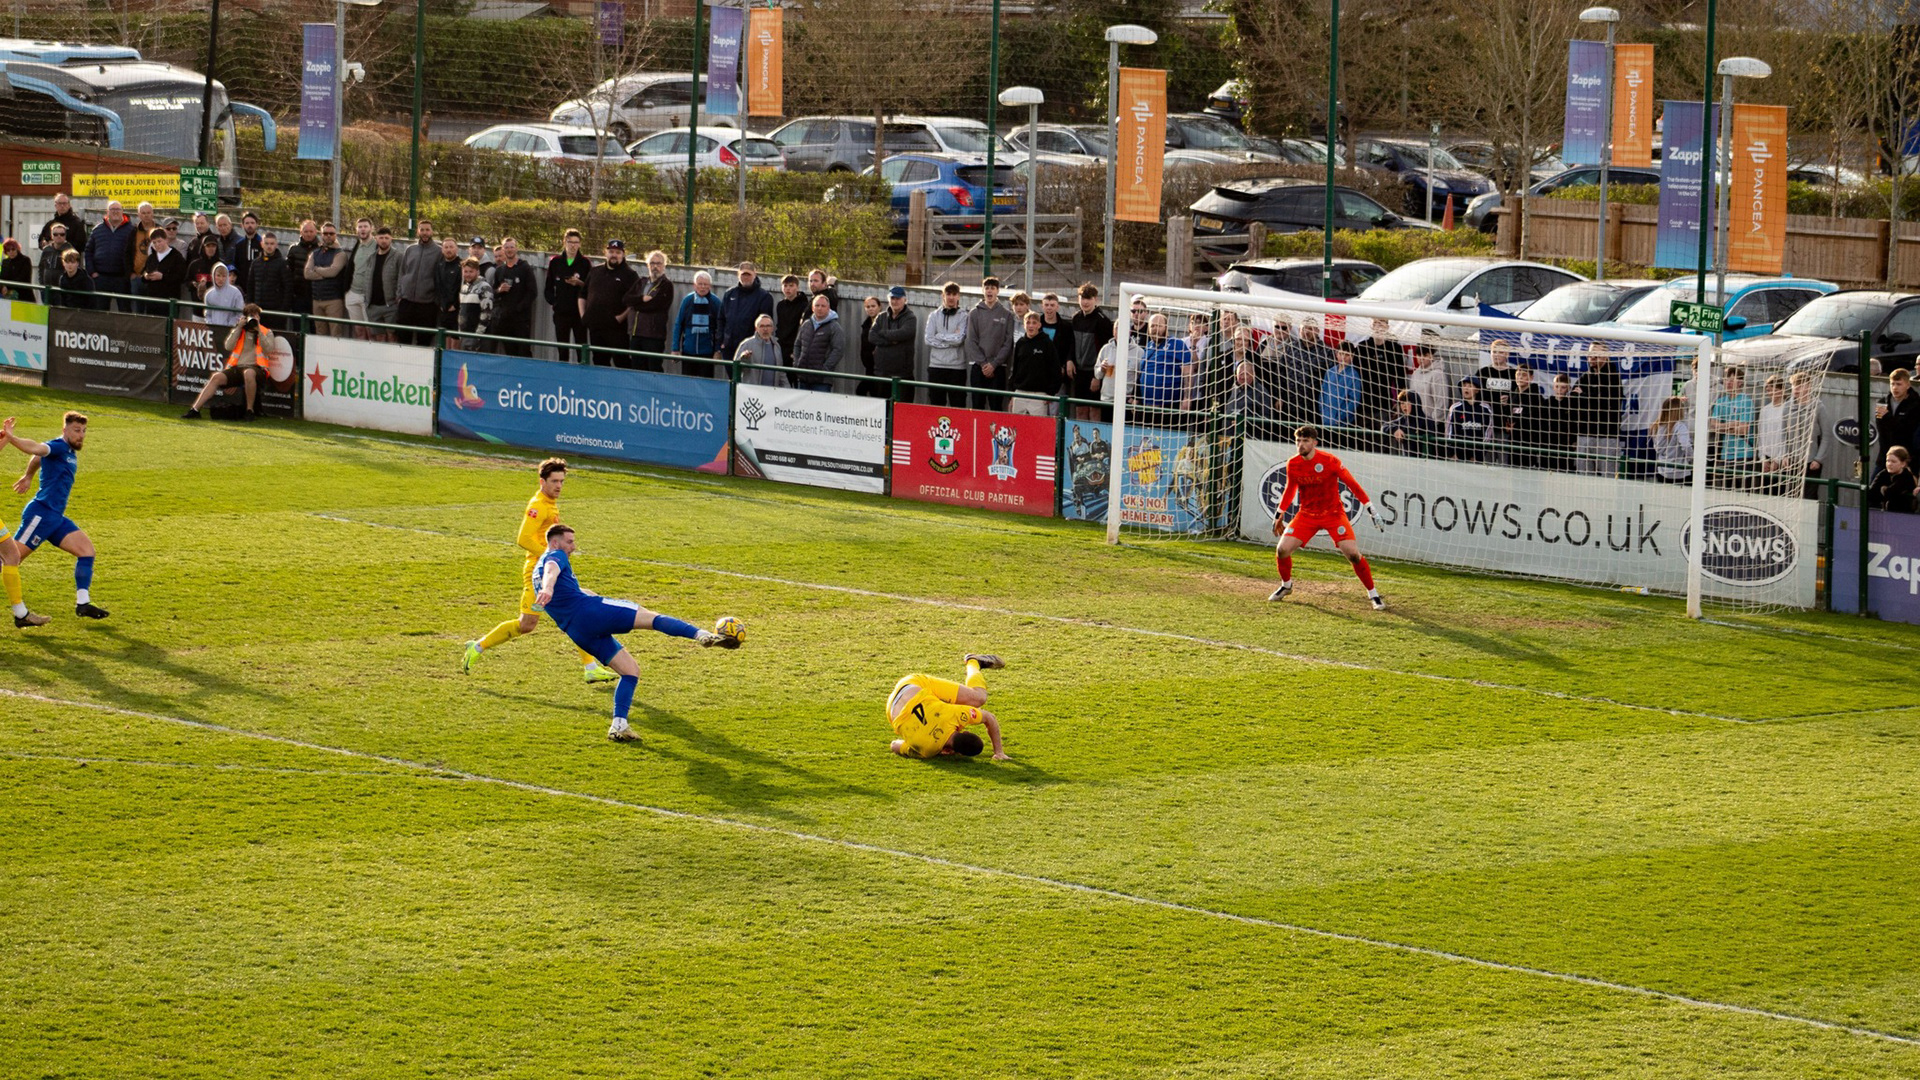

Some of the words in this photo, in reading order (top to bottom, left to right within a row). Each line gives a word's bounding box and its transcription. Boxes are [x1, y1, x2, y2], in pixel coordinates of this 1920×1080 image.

[713, 35, 737, 48] Zappie
[306, 61, 331, 75] Zappie
[762, 48, 770, 90] PANGEA
[1571, 74, 1601, 88] Zappie
[1628, 90, 1638, 139] PANGEA
[1134, 126, 1146, 185] PANGEA
[1669, 147, 1702, 165] Zappi
[181, 167, 195, 175] EXIT
[133, 188, 163, 196] JOURNEY
[203, 180, 217, 188] Fire
[1751, 168, 1764, 233] PANGEA
[1702, 309, 1720, 320] Fire
[1701, 320, 1718, 329] exit
[29, 333, 42, 341] League
[55, 330, 110, 352] macron
[177, 327, 214, 348] MAKE
[129, 345, 161, 354] GLOUCESTER
[1519, 332, 1636, 370] STAS
[77, 358, 105, 366] PROFESSIONAL
[178, 349, 223, 371] WAVES
[332, 369, 432, 407] Heineken
[498, 383, 533, 411] eric
[539, 389, 622, 421] robinson
[628, 397, 714, 432] solicitors
[774, 406, 814, 420] Protection
[816, 411, 822, 421] &
[824, 412, 868, 427] Investment
[870, 417, 882, 429] Ltd
[774, 421, 818, 435] Independent
[819, 425, 851, 438] Financial
[852, 430, 882, 442] Advisers
[1838, 425, 1875, 439] SNOS
[556, 433, 624, 450] ericrobinson.co.uk
[919, 484, 960, 498] OFFICIAL
[964, 489, 985, 501] CLUB
[988, 492, 1025, 506] PARTNER
[1123, 495, 1144, 507] UK'S
[1146, 497, 1167, 510] NO.1
[1120, 510, 1148, 522] HEME
[1149, 513, 1174, 526] PARK
[1381, 489, 1661, 557] snows.co.uk
[1867, 542, 1920, 595] Zap
[911, 702, 928, 726] 4
